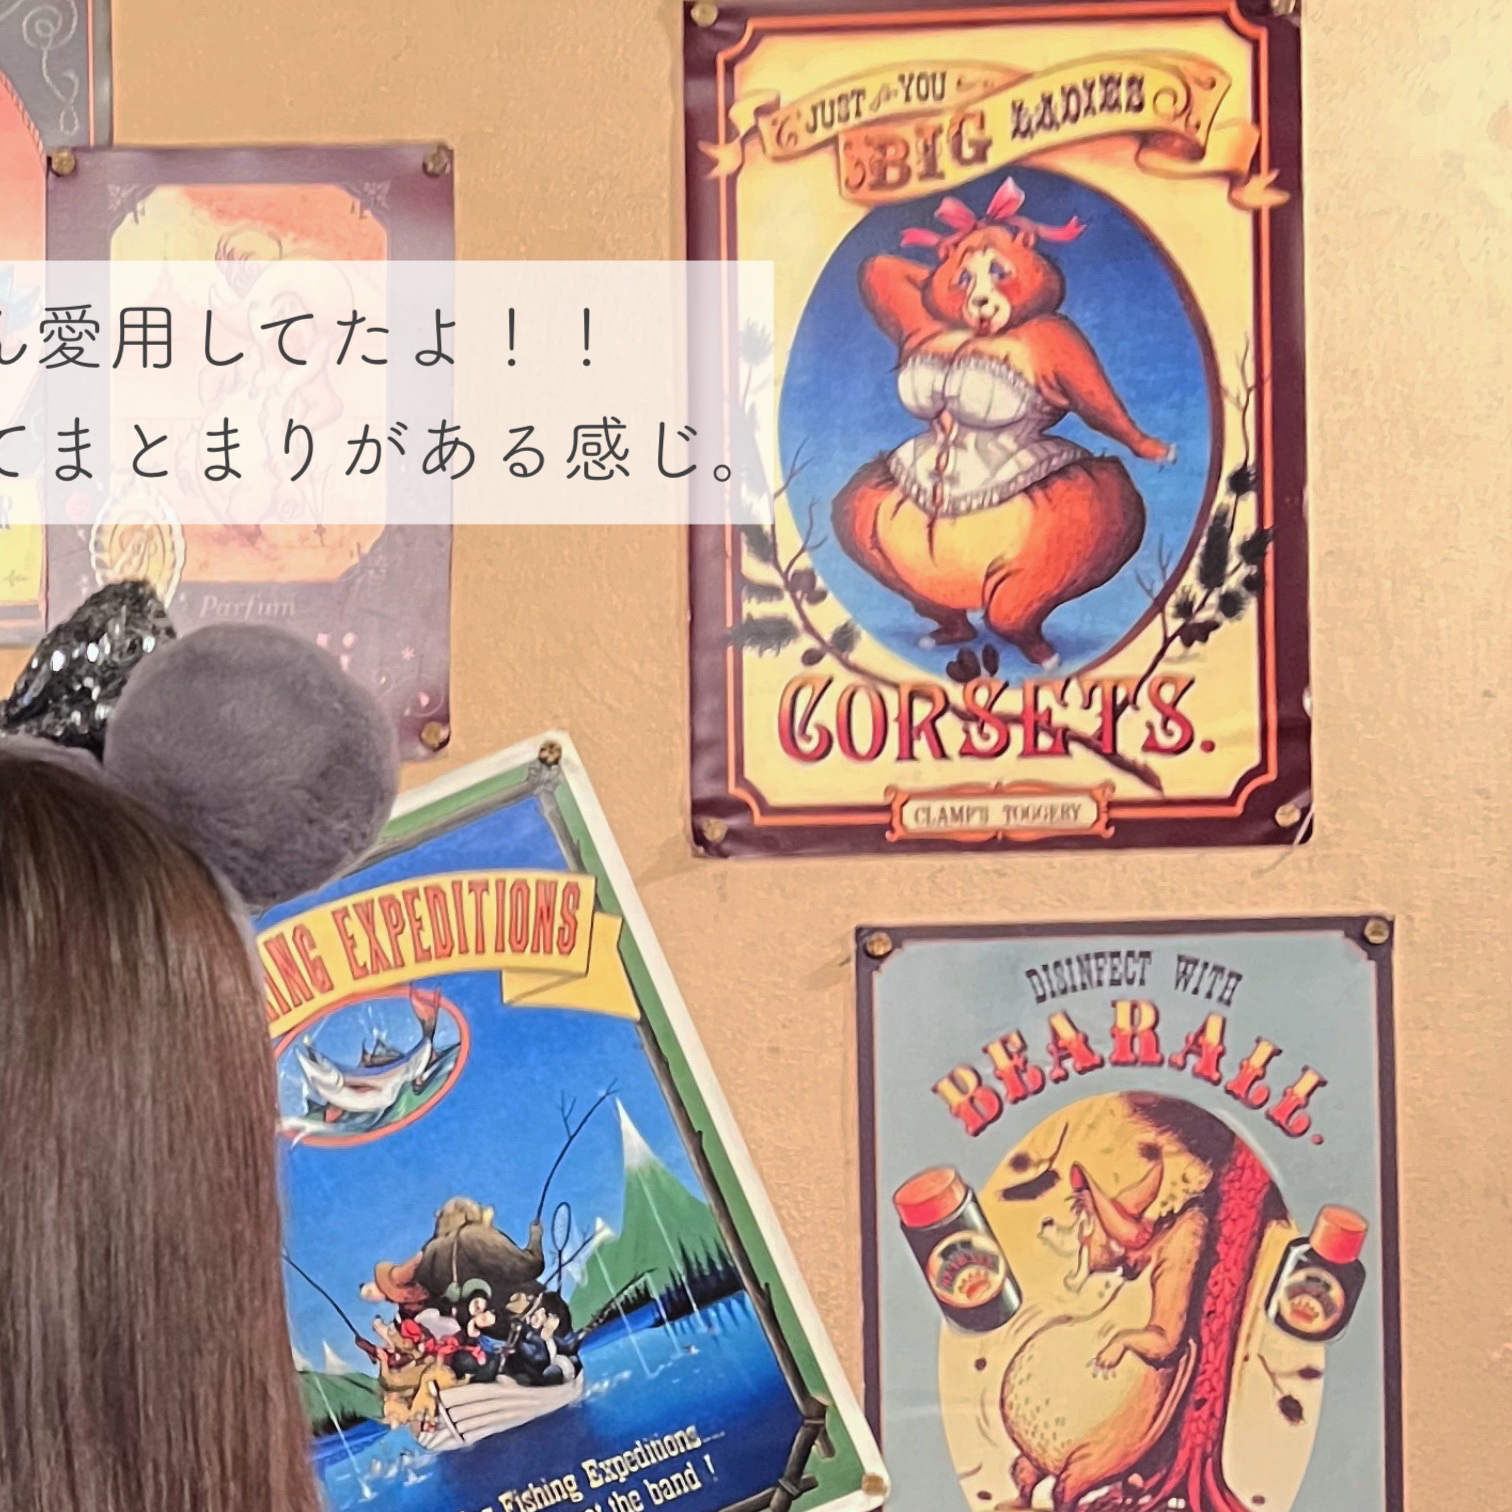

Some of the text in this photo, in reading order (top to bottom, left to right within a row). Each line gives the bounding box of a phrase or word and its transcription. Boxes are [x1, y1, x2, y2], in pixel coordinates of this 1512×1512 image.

[805, 88, 867, 134] JUST
[898, 71, 948, 104] YOU
[864, 72, 1146, 191] BIG LADIES
[777, 673, 1217, 764] CORSETS.
[263, 877, 581, 1023] ING EXPEDITIONS
[1024, 949, 1244, 1008] DISINFECT WITH
